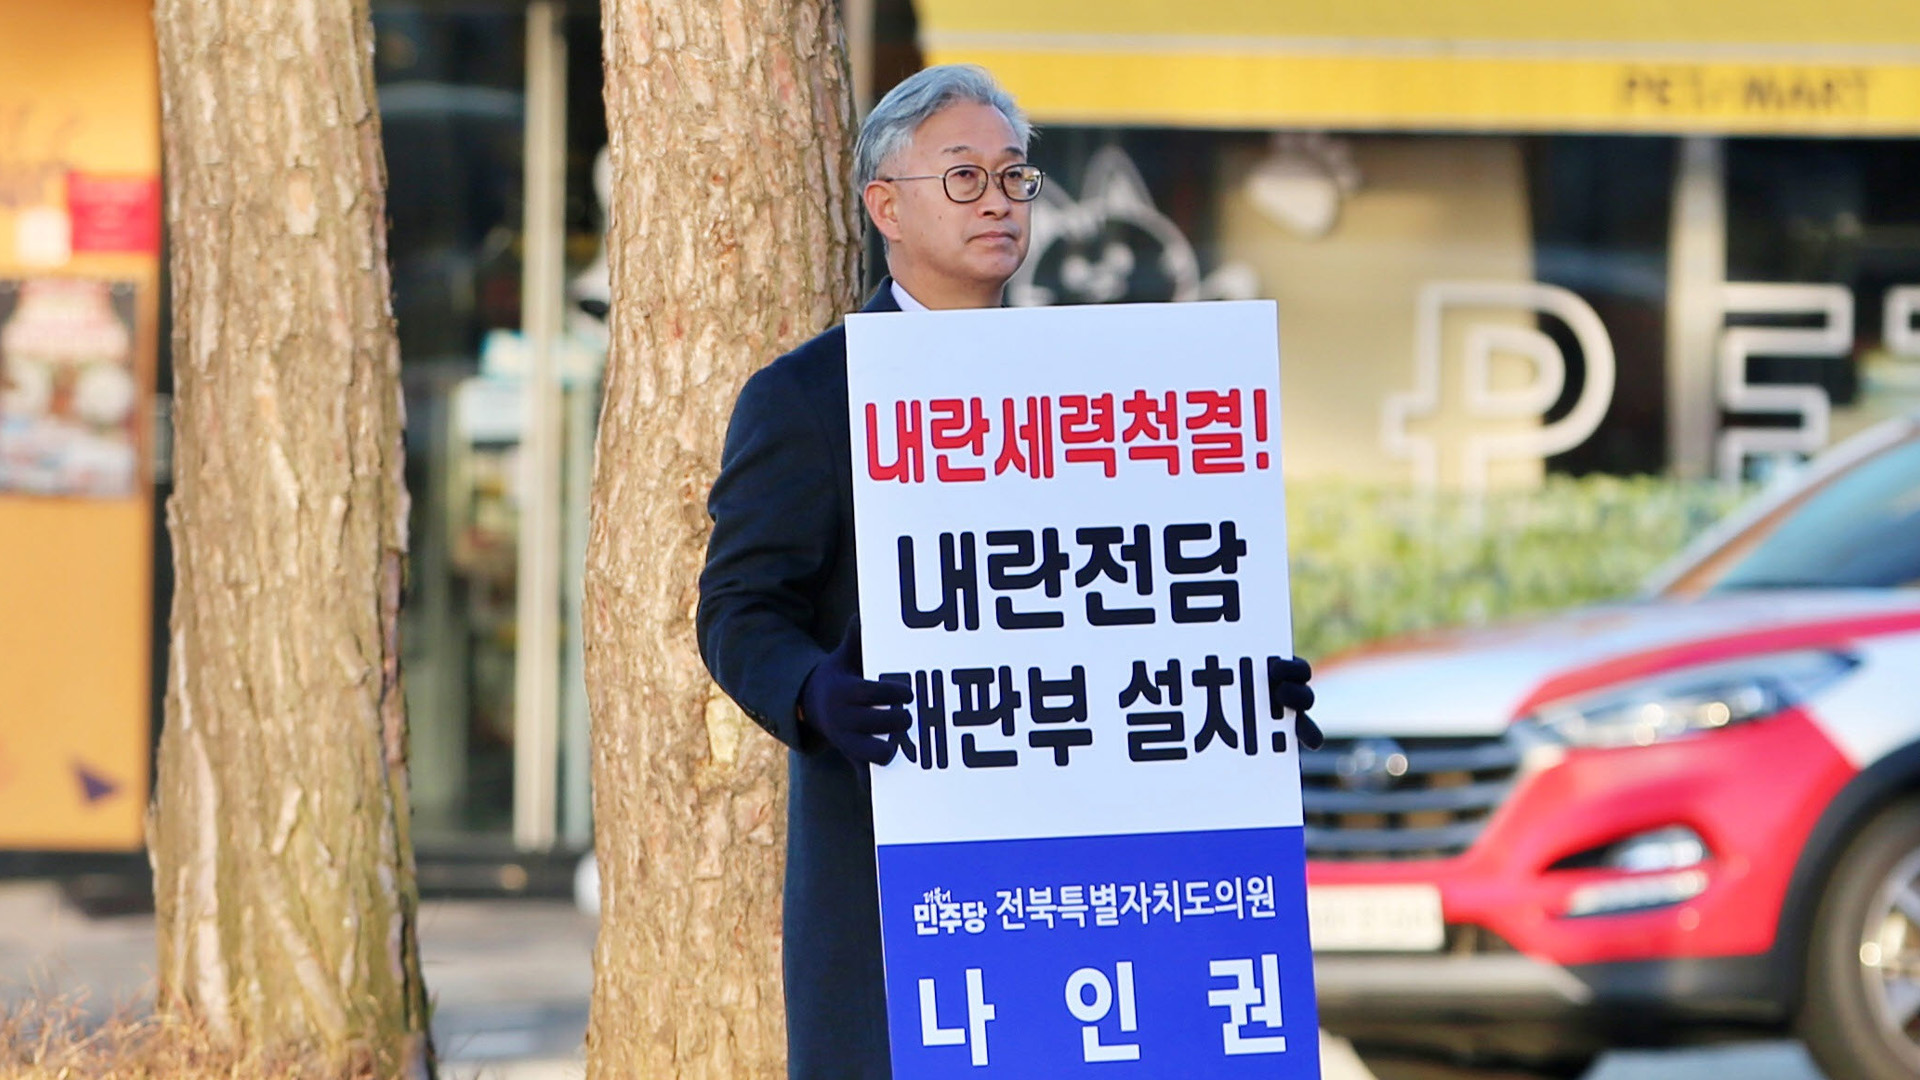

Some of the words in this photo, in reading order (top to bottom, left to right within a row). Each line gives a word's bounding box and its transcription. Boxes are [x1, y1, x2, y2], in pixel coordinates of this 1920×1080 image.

[864, 387, 1270, 484] 내란세력척결!
[1379, 280, 1920, 500] PE
[897, 520, 1248, 632] 내란전담
[1118, 654, 1287, 762] 설치!
[913, 900, 988, 935] 민주당
[995, 875, 1277, 931] 전북특별자치도의원
